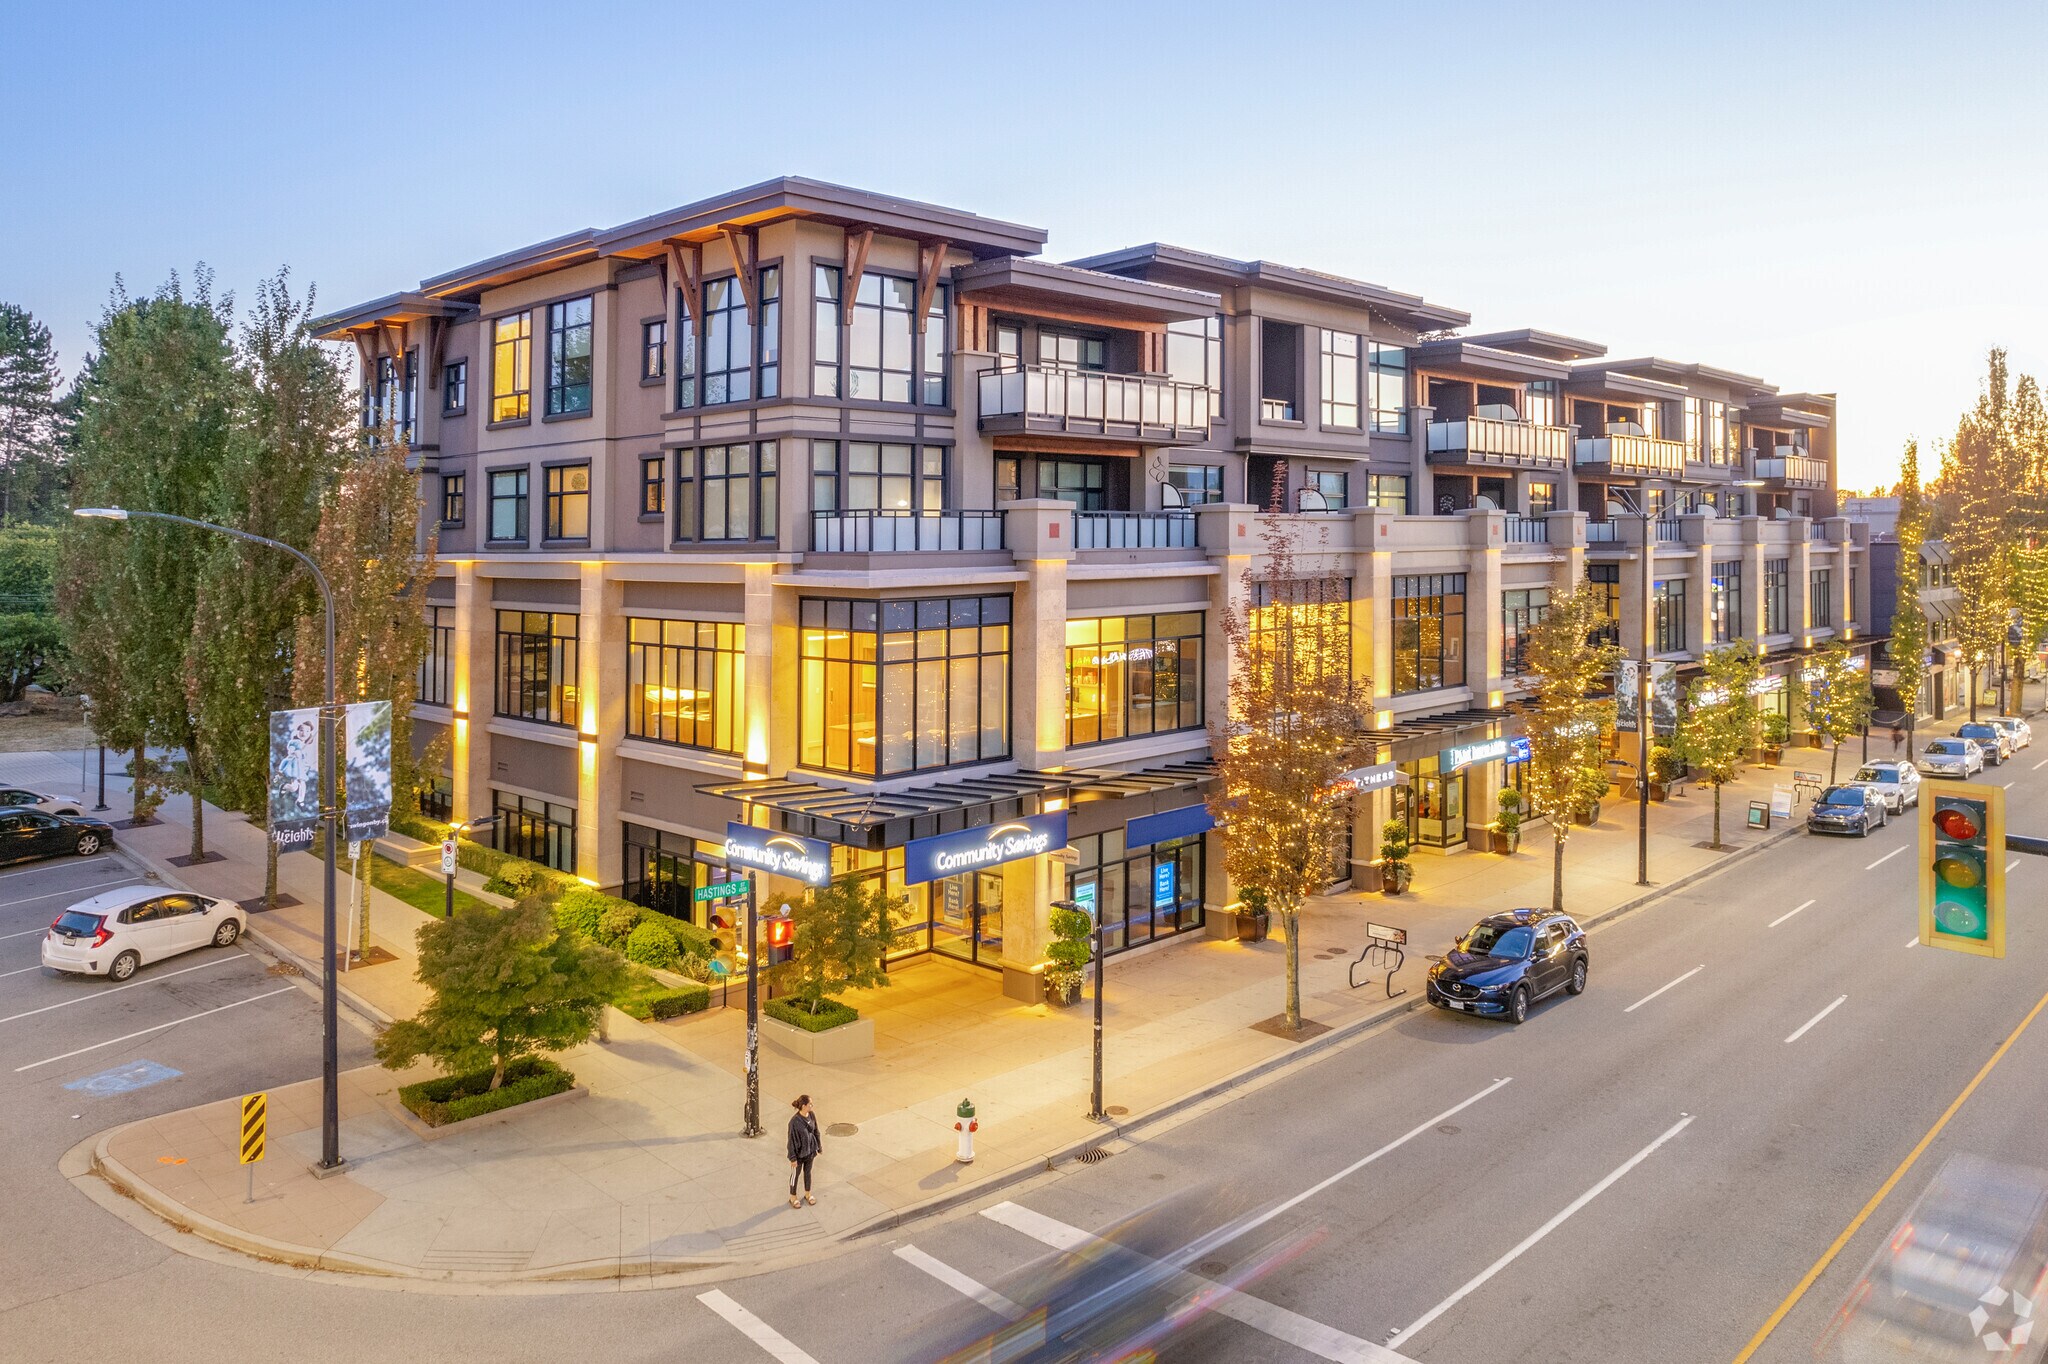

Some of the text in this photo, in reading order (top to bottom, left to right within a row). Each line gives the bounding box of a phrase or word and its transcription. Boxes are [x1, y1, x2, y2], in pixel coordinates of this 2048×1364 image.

[936, 832, 1049, 870] Community Savings
[725, 838, 826, 882] Community Savings
[697, 883, 737, 900] HASTINGS
[947, 889, 960, 897] Here?
[948, 896, 959, 904] Bank
